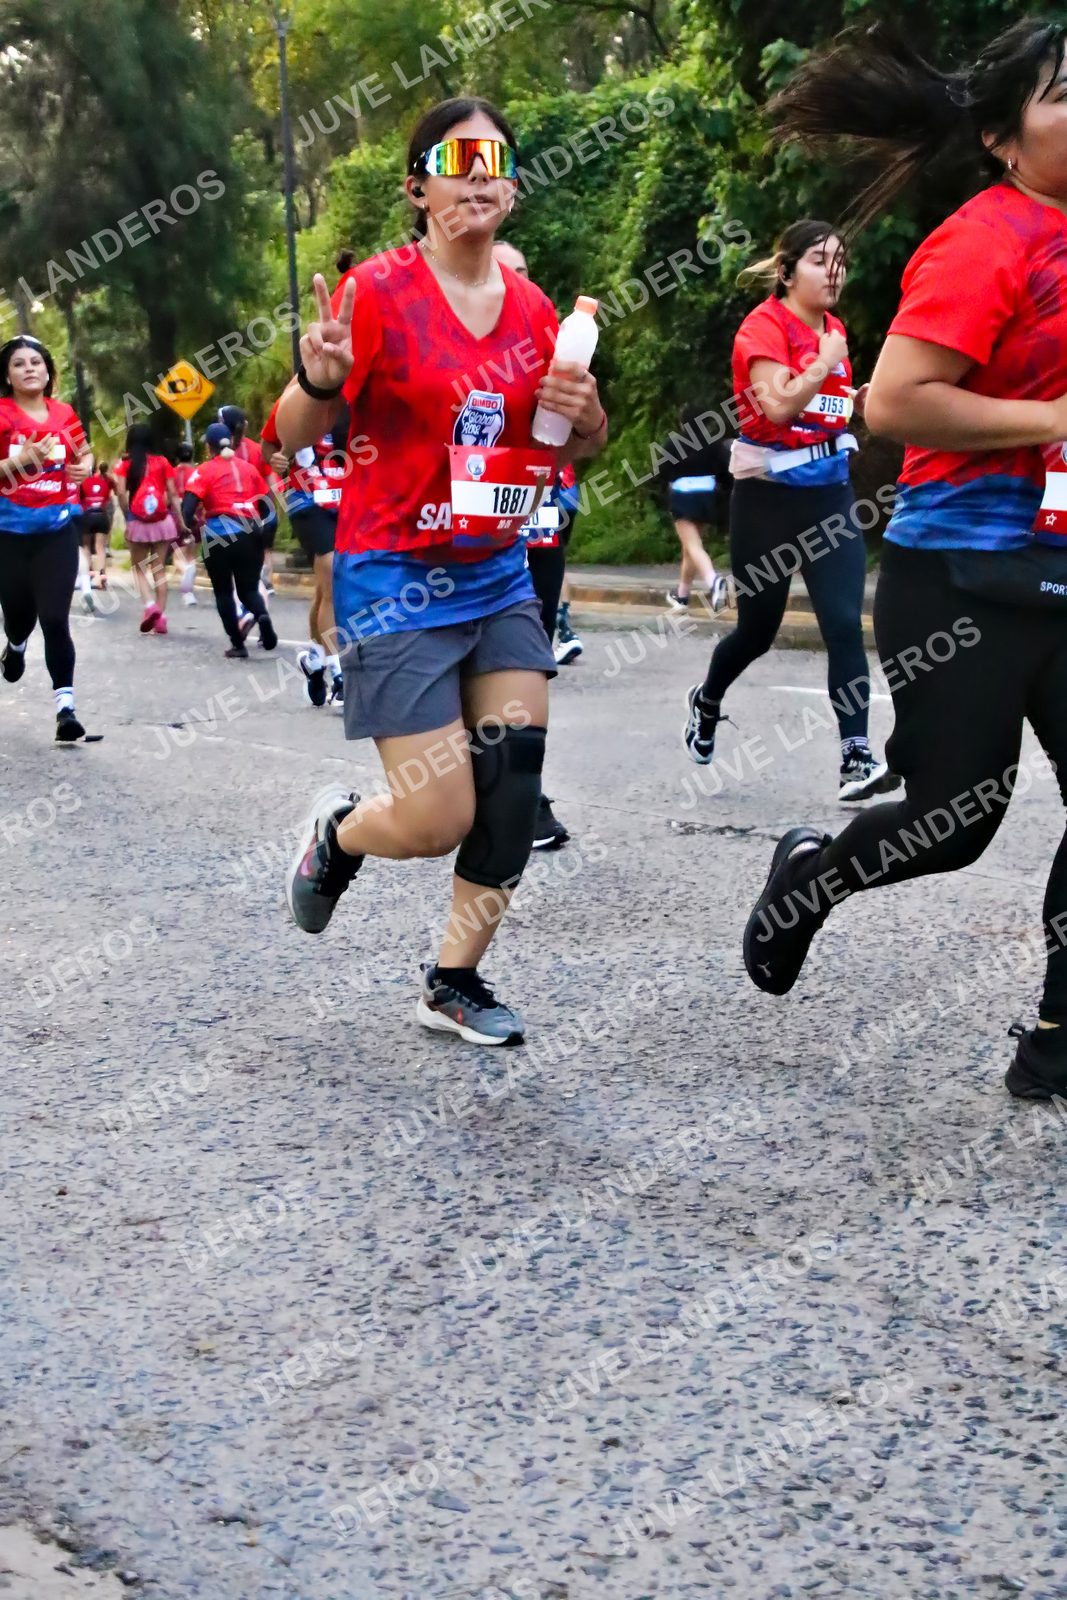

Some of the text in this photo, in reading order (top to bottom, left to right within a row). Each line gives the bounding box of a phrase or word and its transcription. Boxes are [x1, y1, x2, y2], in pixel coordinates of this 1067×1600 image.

[472, 398, 498, 409] BIMBO
[819, 396, 844, 414] 3153
[469, 411, 496, 425] Global
[493, 486, 528, 514] 1881
[417, 502, 453, 530] SA
[1040, 581, 1067, 595] SPOR
